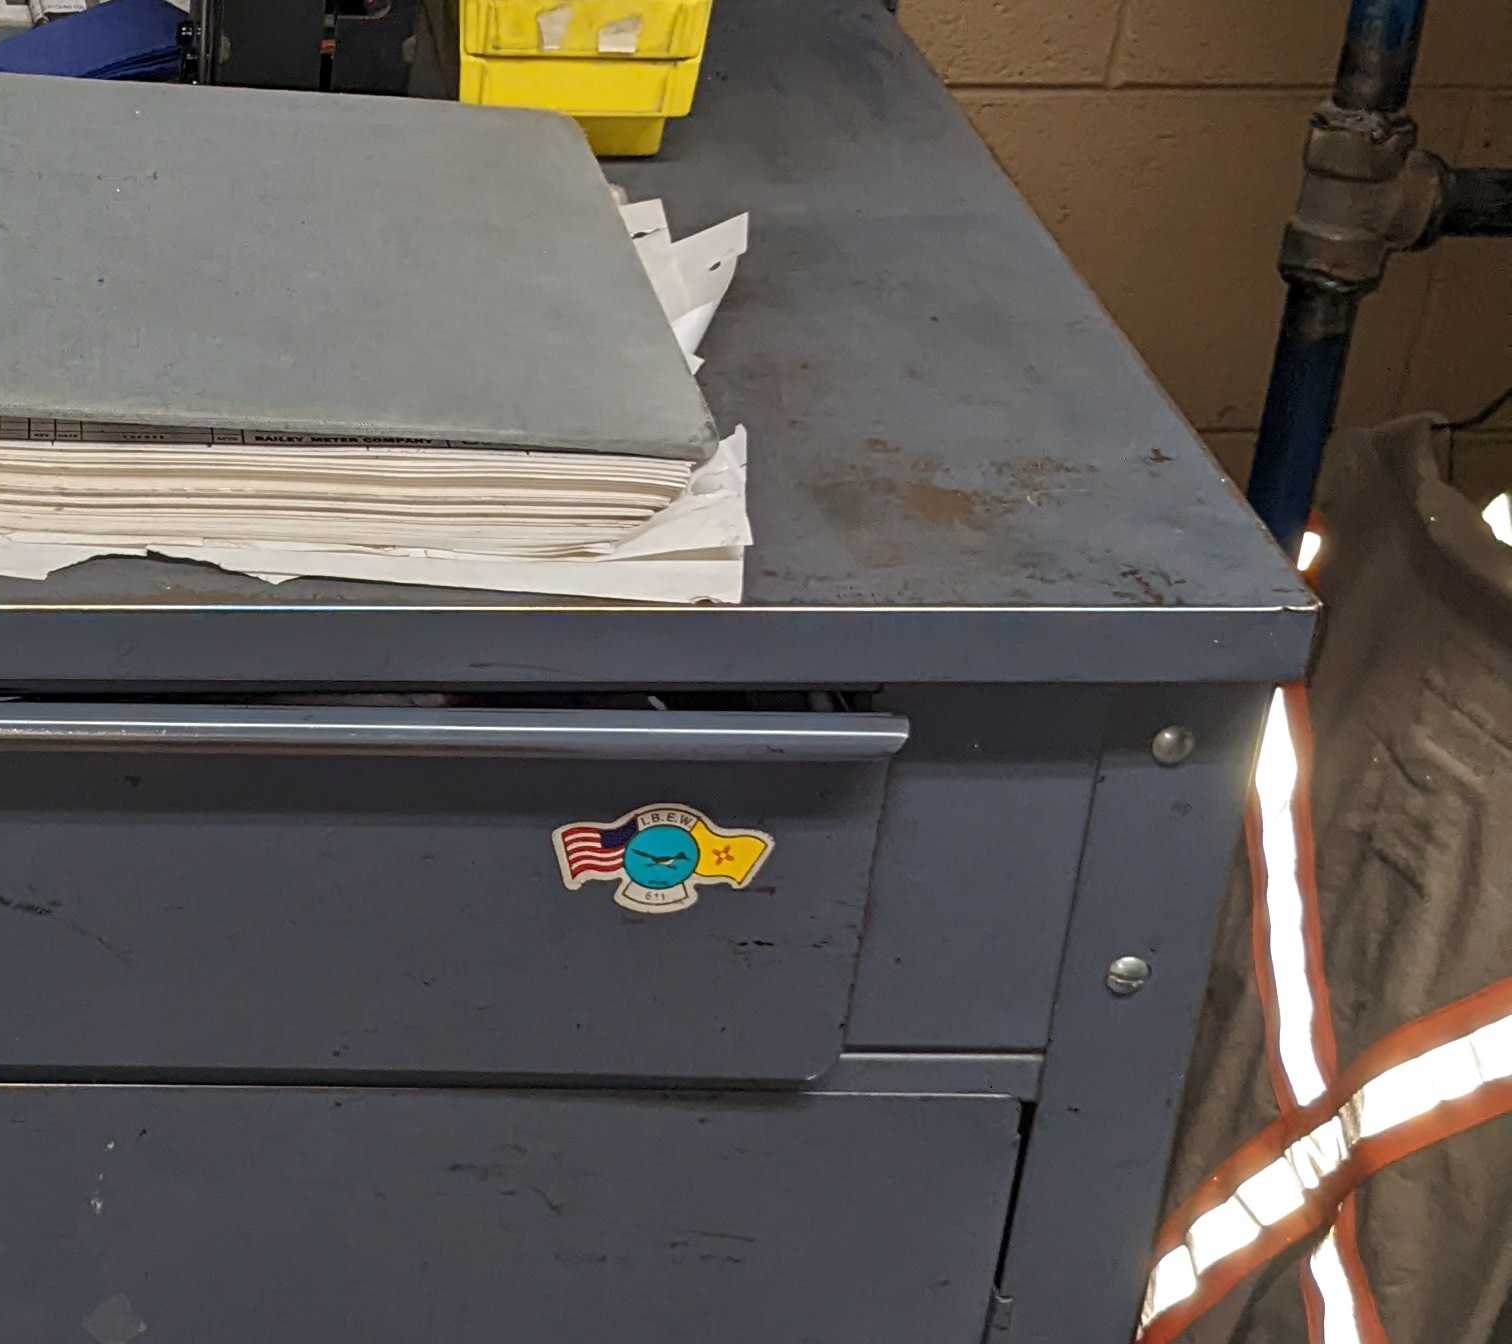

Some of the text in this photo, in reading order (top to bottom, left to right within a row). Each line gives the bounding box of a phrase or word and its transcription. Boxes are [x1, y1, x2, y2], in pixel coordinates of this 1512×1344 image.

[253, 434, 434, 445] BAILEY METER COMPANY
